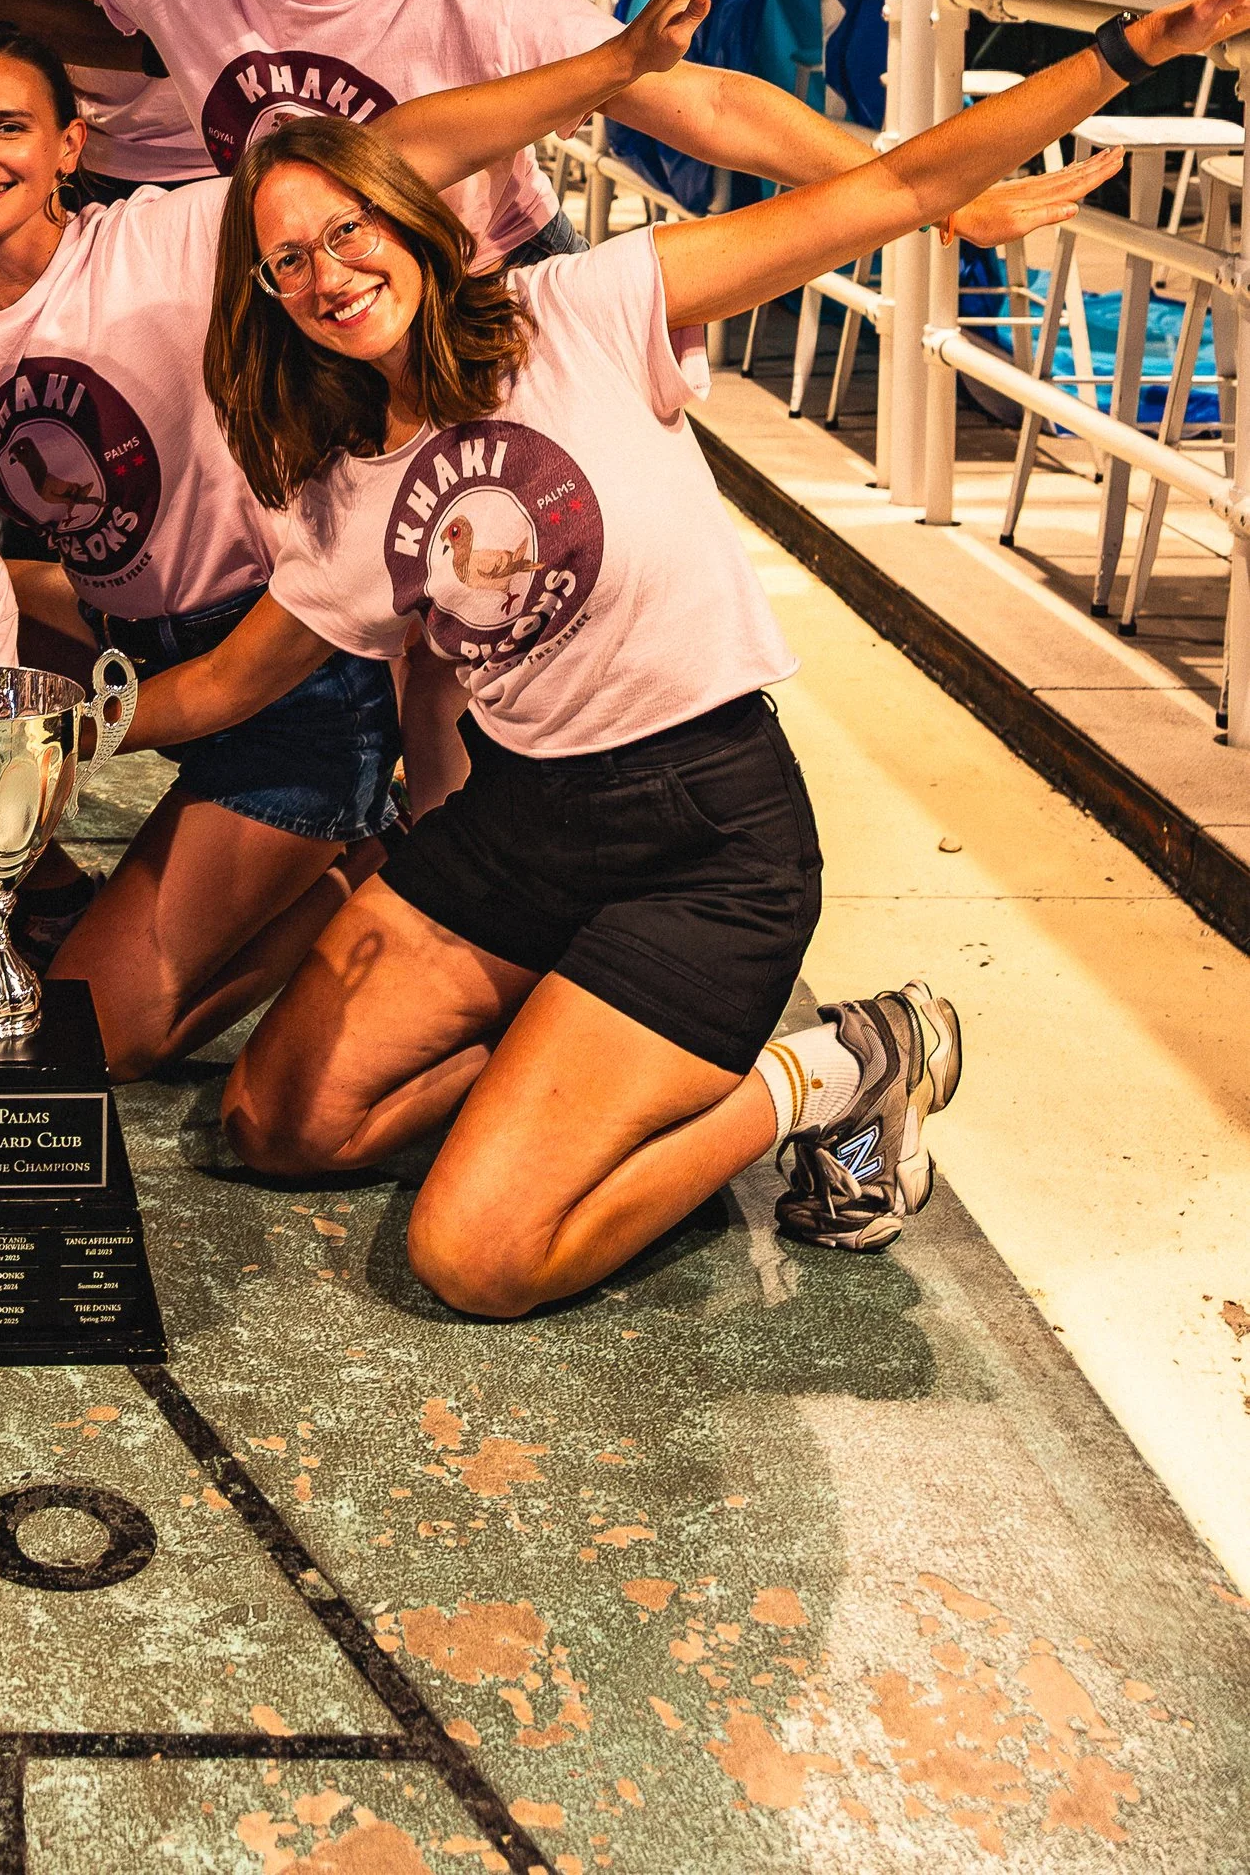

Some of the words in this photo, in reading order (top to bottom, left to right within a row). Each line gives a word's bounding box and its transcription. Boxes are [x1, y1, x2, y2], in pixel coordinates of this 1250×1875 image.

[236, 64, 377, 125] KHAKI
[208, 126, 235, 145] ROYAL
[103, 436, 140, 462] PALMS
[394, 437, 508, 557] KHAKI
[537, 479, 576, 510] PALMS
[527, 646, 554, 665] THE
[555, 612, 592, 646] FENCE
[64, 1237, 87, 1245] TANG
[88, 1236, 134, 1245] AFFILIATED
[85, 1248, 96, 1256] Fall
[77, 1282, 103, 1290] Summer
[73, 1304, 91, 1312] THE
[92, 1304, 122, 1312] DONKS
[79, 1315, 99, 1324] Spring
